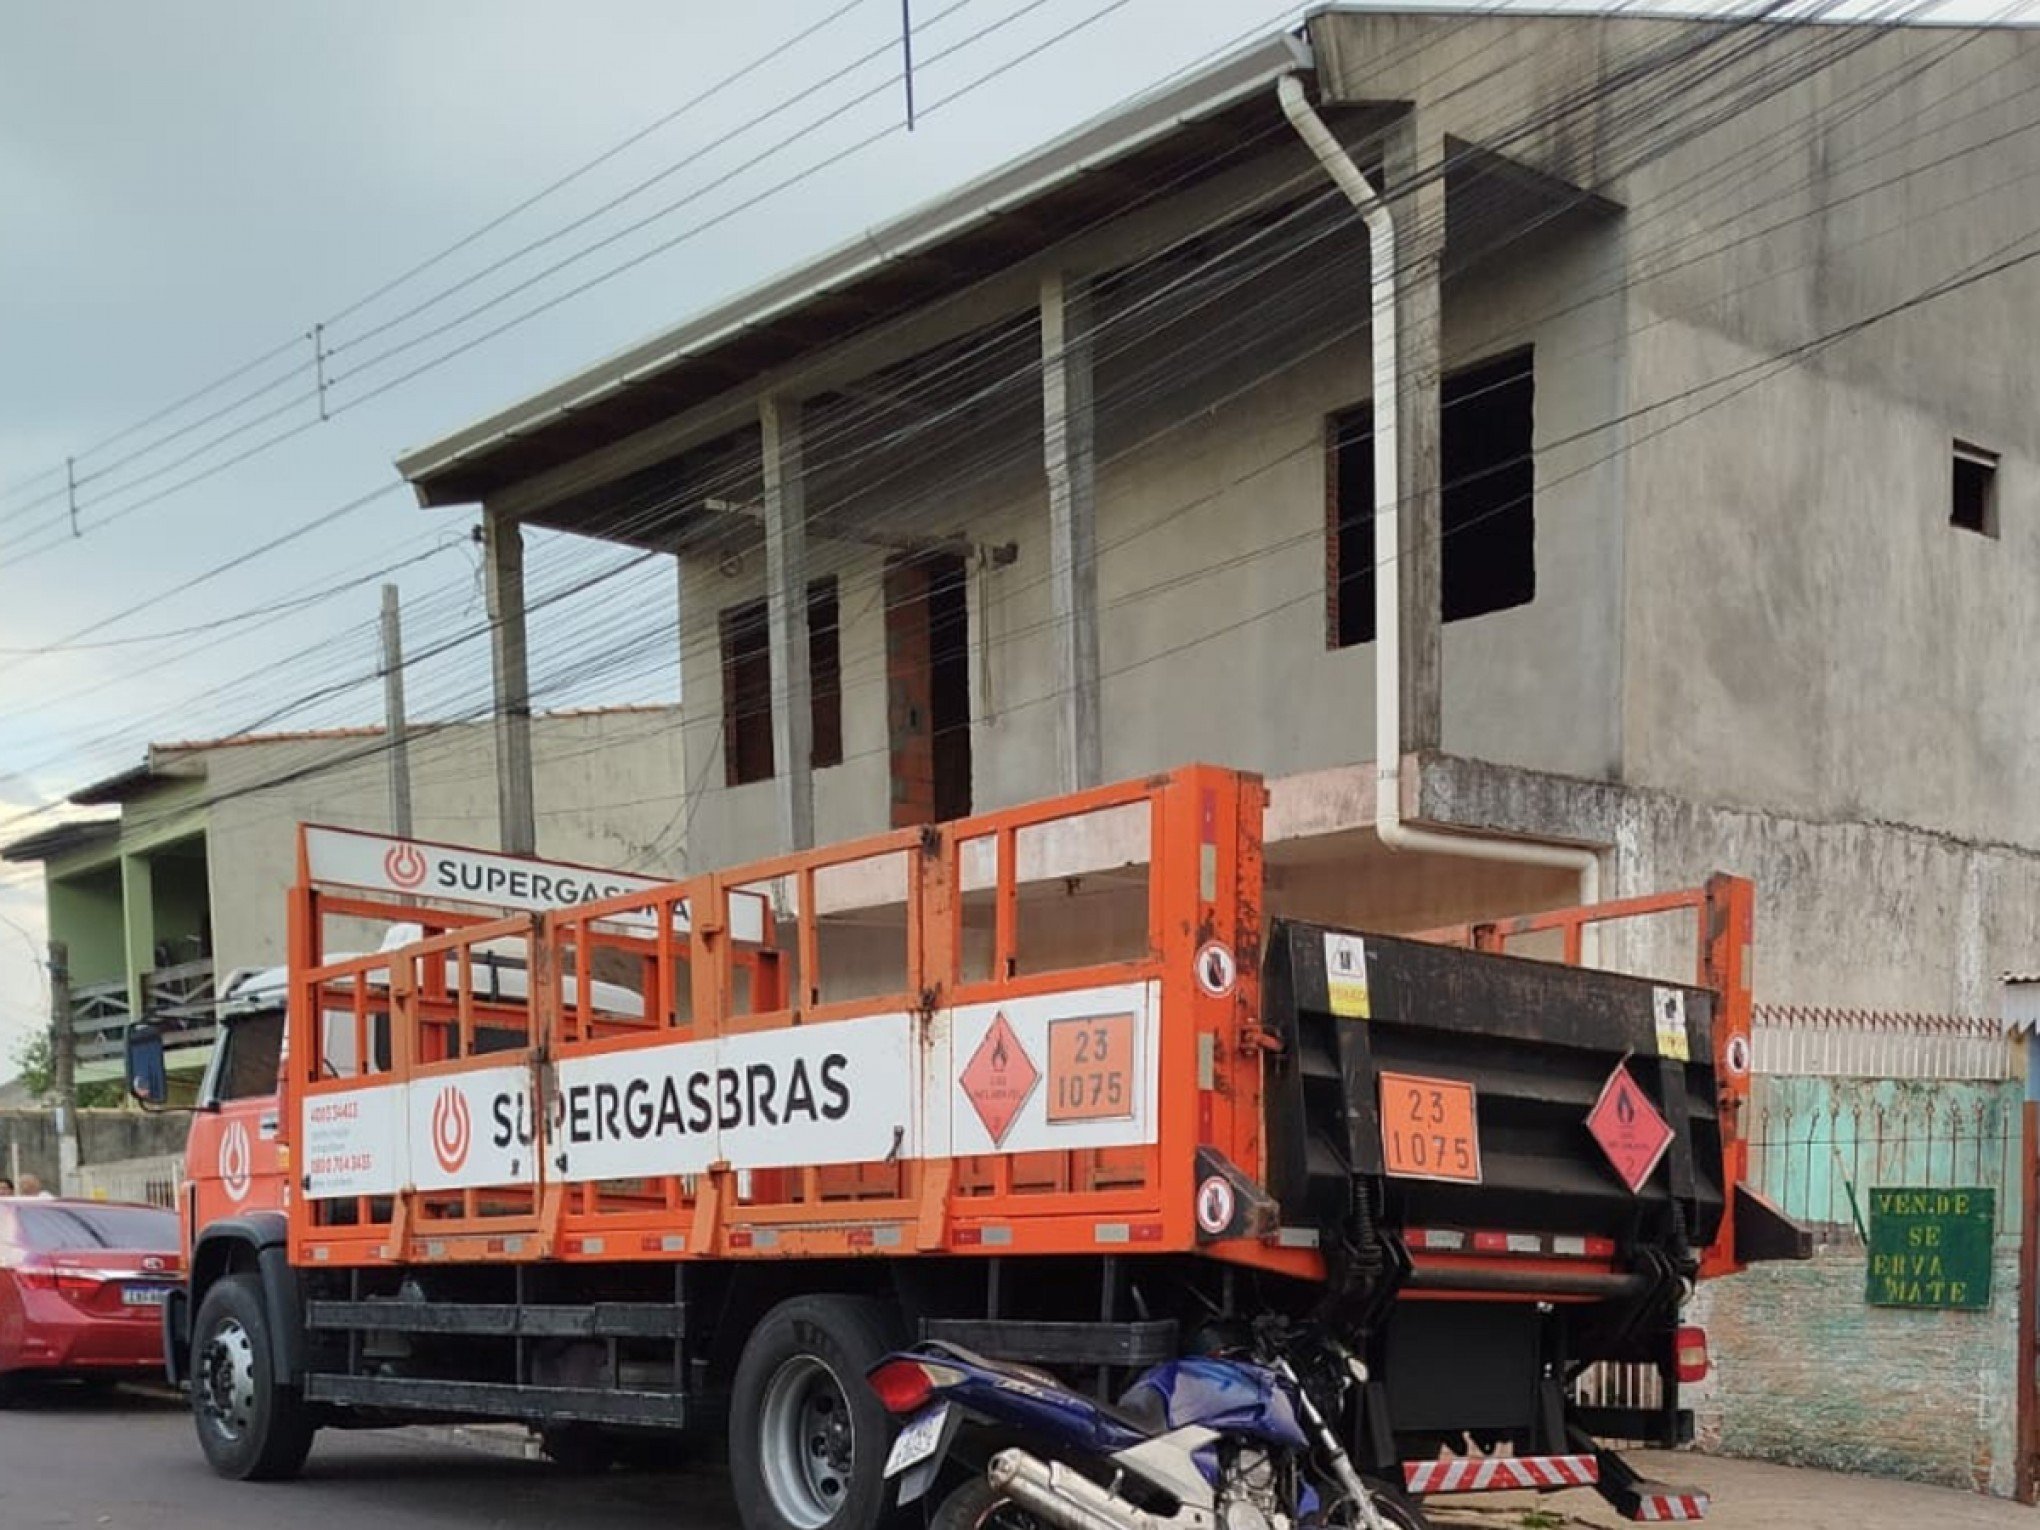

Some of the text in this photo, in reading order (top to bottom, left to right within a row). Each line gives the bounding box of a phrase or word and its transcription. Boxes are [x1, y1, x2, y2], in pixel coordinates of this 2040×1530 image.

[1075, 1029, 1107, 1063] 23
[1059, 1072, 1122, 1109] 1075
[1408, 1089, 1445, 1123] 23
[1393, 1131, 1469, 1169] 1075
[1908, 1226, 1941, 1247] SE
